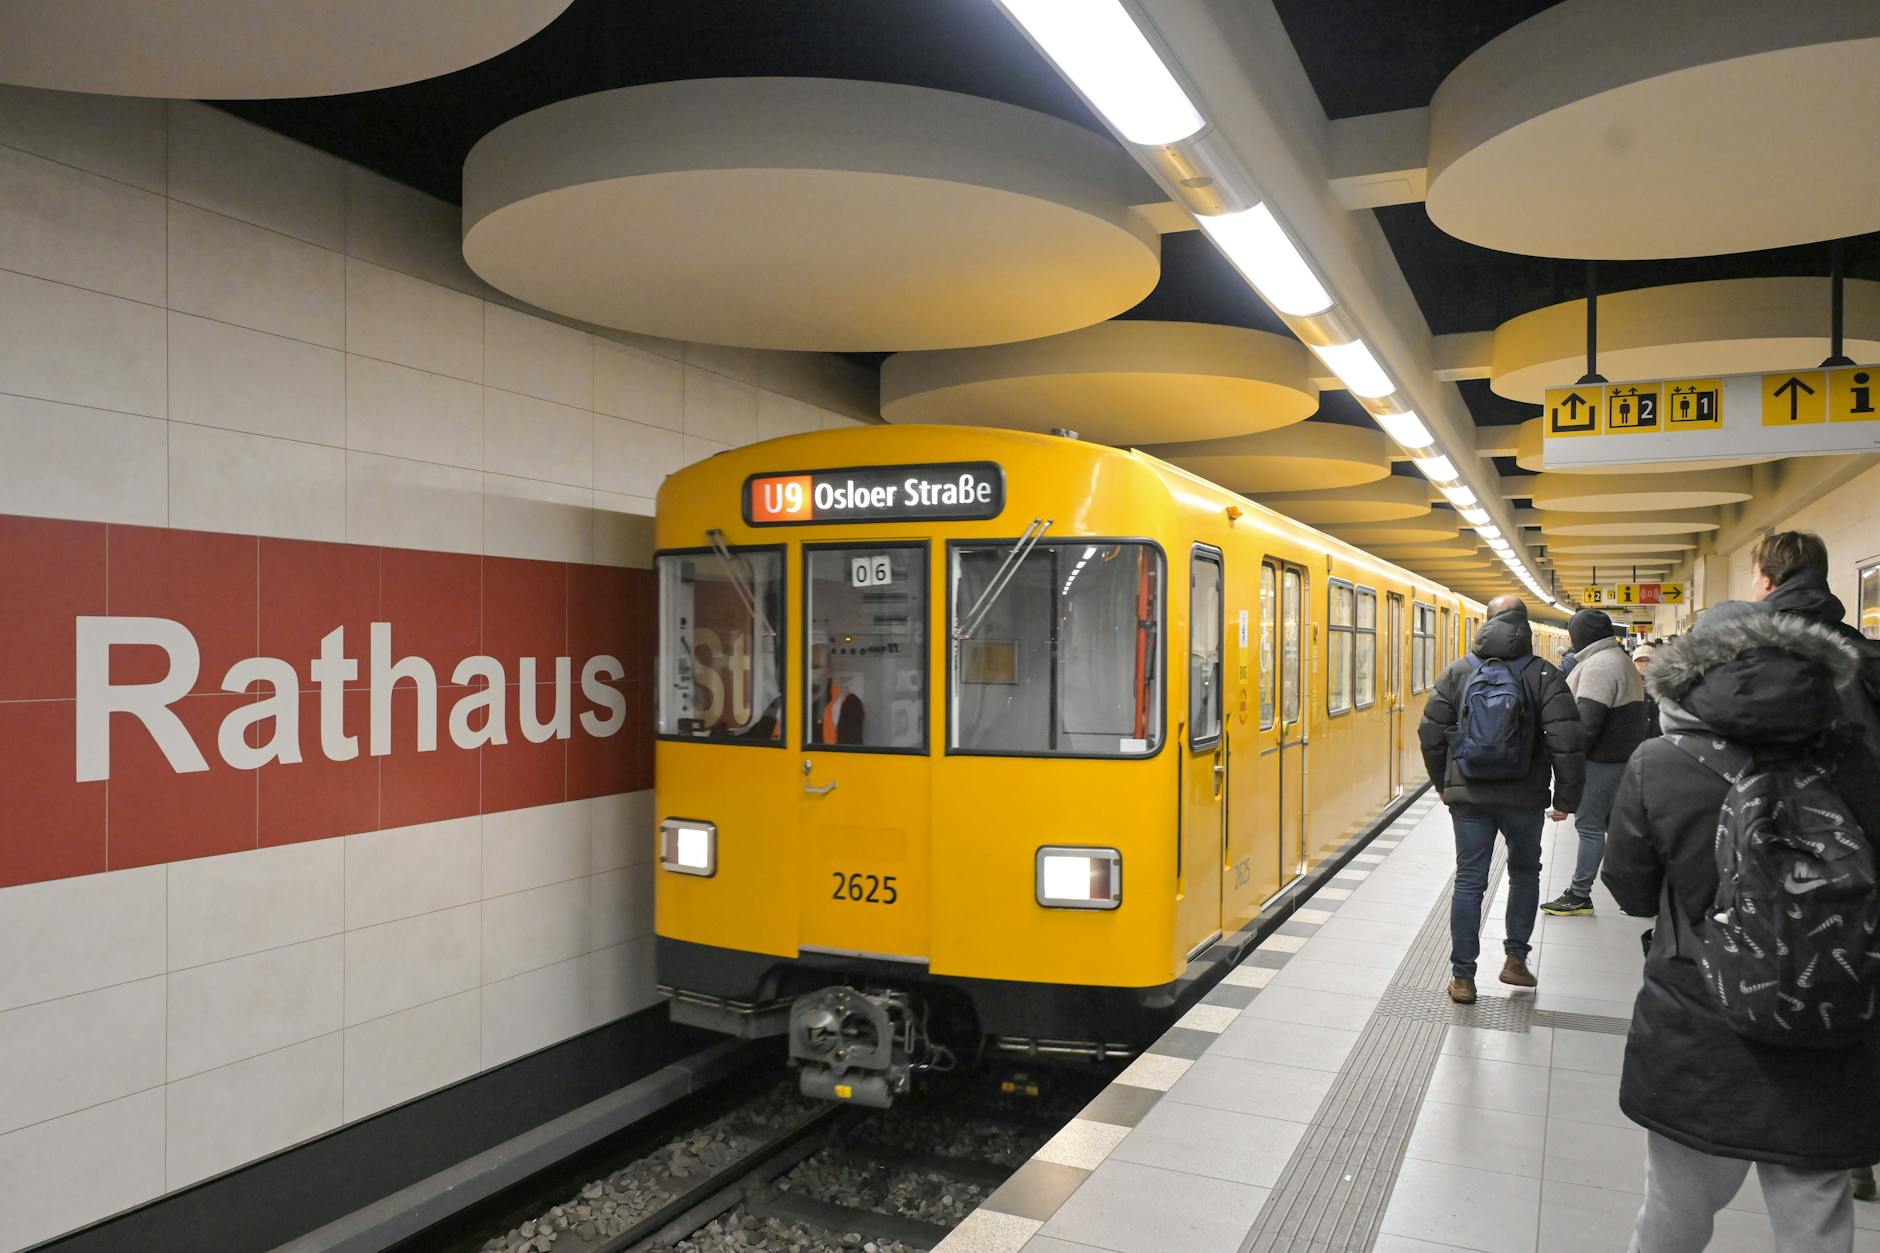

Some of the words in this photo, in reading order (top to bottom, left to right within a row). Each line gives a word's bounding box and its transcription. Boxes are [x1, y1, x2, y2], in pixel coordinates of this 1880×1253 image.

[1640, 400, 1653, 419] 2
[1700, 397, 1708, 414] 1
[764, 482, 803, 513] U9
[814, 480, 898, 510] Osloer
[904, 474, 992, 506] Straße
[856, 563, 886, 583] 06
[75, 615, 627, 783] Rathaus
[832, 872, 897, 904] 2625
